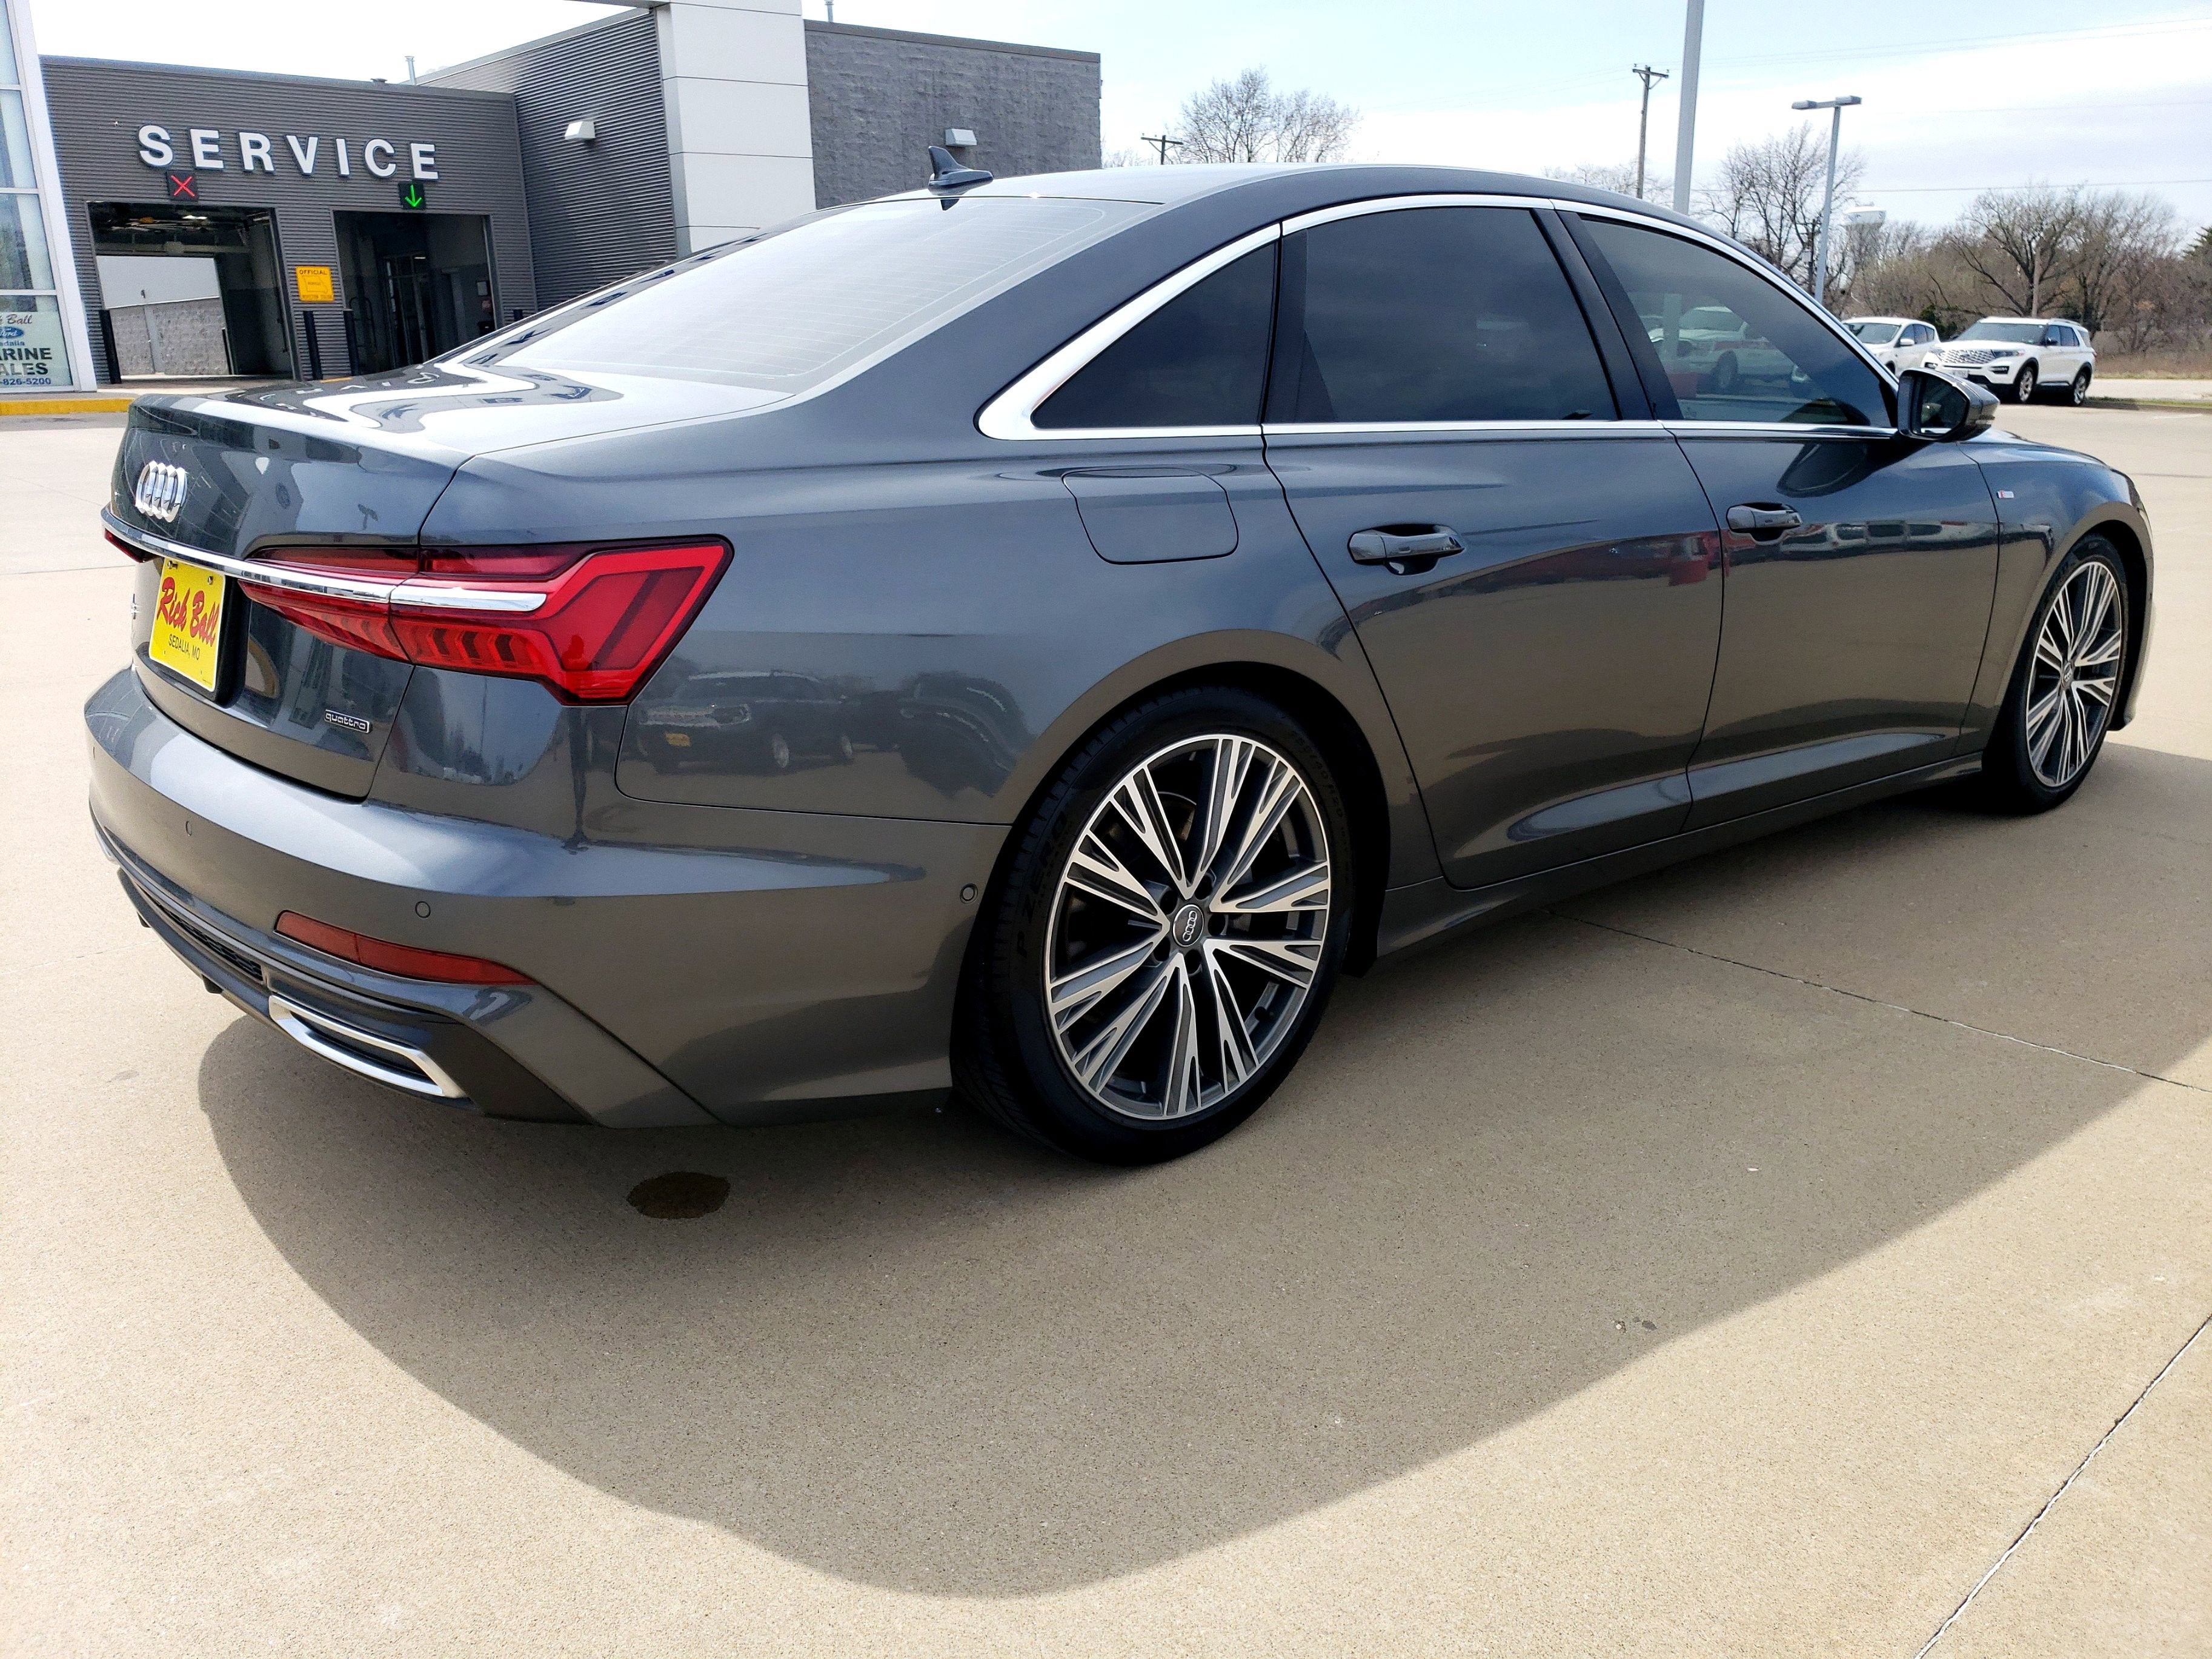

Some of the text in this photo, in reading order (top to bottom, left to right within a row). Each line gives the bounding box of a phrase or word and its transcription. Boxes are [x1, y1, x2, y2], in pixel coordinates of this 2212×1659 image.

[138, 124, 439, 180] SERVICE
[6, 314, 32, 324] Ball
[0, 347, 52, 361] RINE
[157, 577, 191, 632] Rich
[190, 590, 220, 647] Ball
[168, 633, 201, 660] SEDALIA, MO
[325, 713, 366, 730] quattro
[1021, 810, 1068, 923] ZERO
